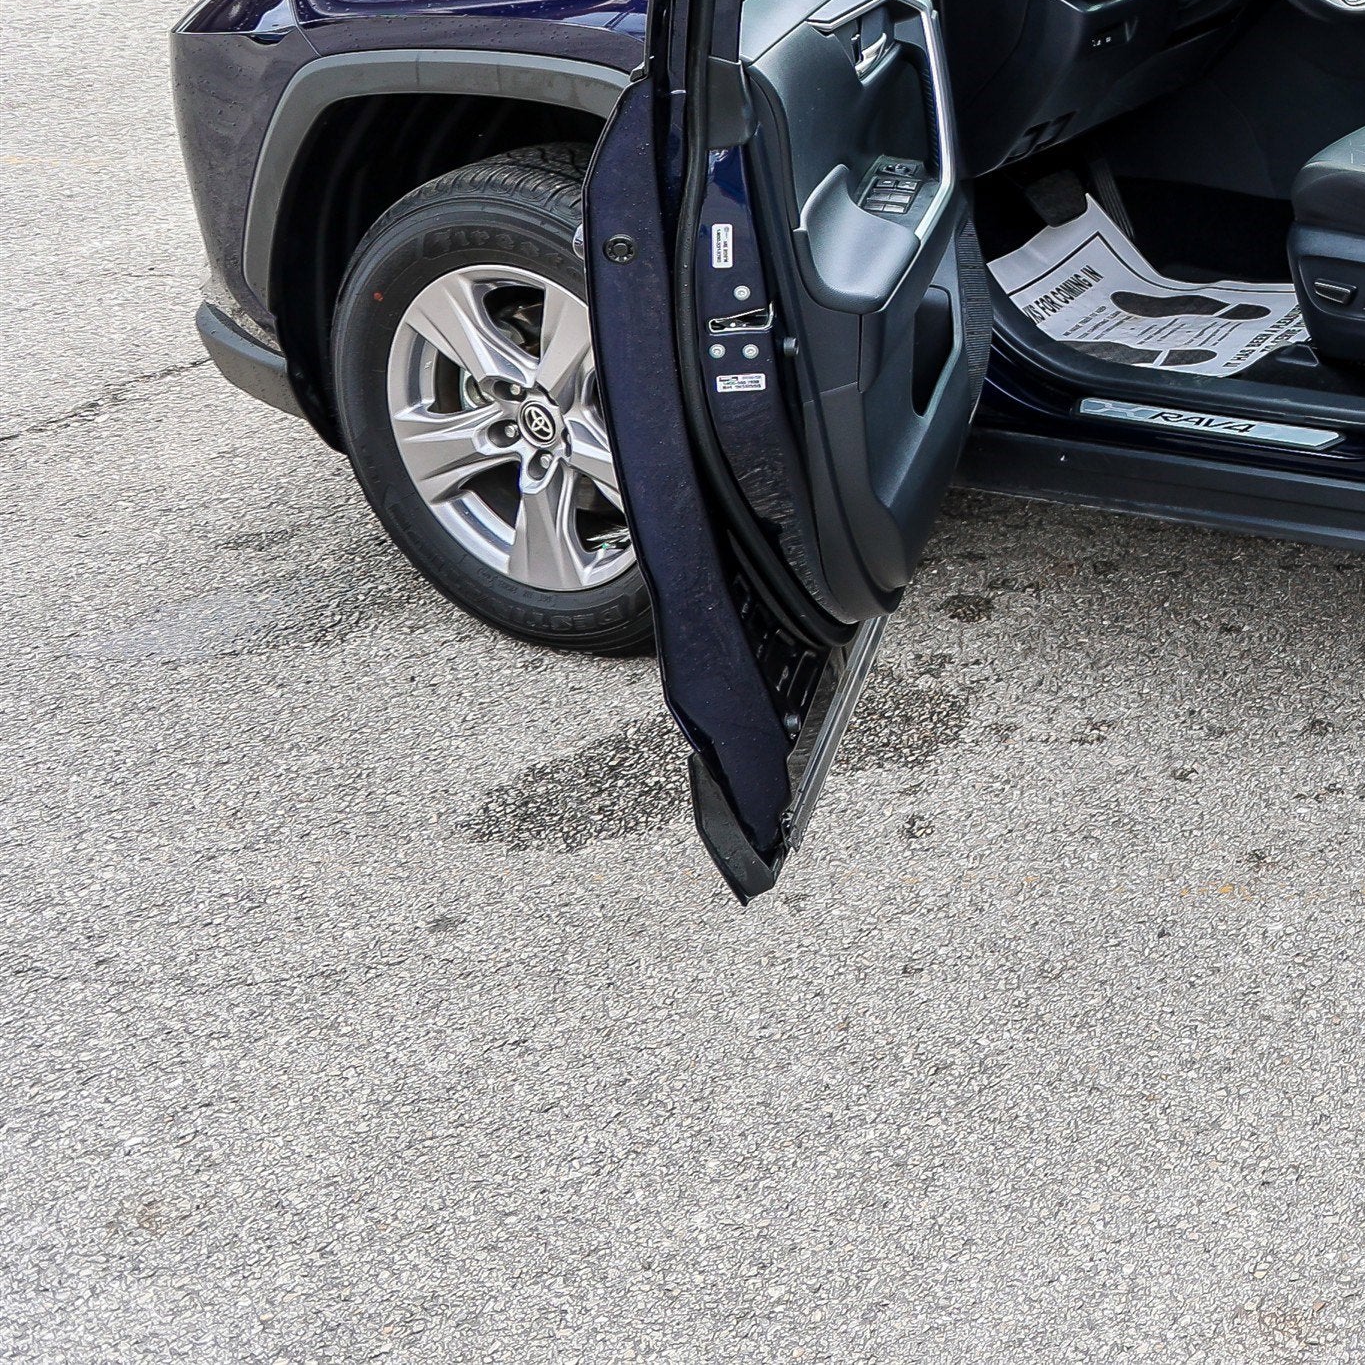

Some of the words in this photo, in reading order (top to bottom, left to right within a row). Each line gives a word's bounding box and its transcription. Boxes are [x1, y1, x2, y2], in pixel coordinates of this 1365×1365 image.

[1034, 294, 1063, 316] FOR
[1050, 273, 1093, 304] COMING
[1080, 264, 1103, 282] IN
[1149, 412, 1256, 433] RAV4
